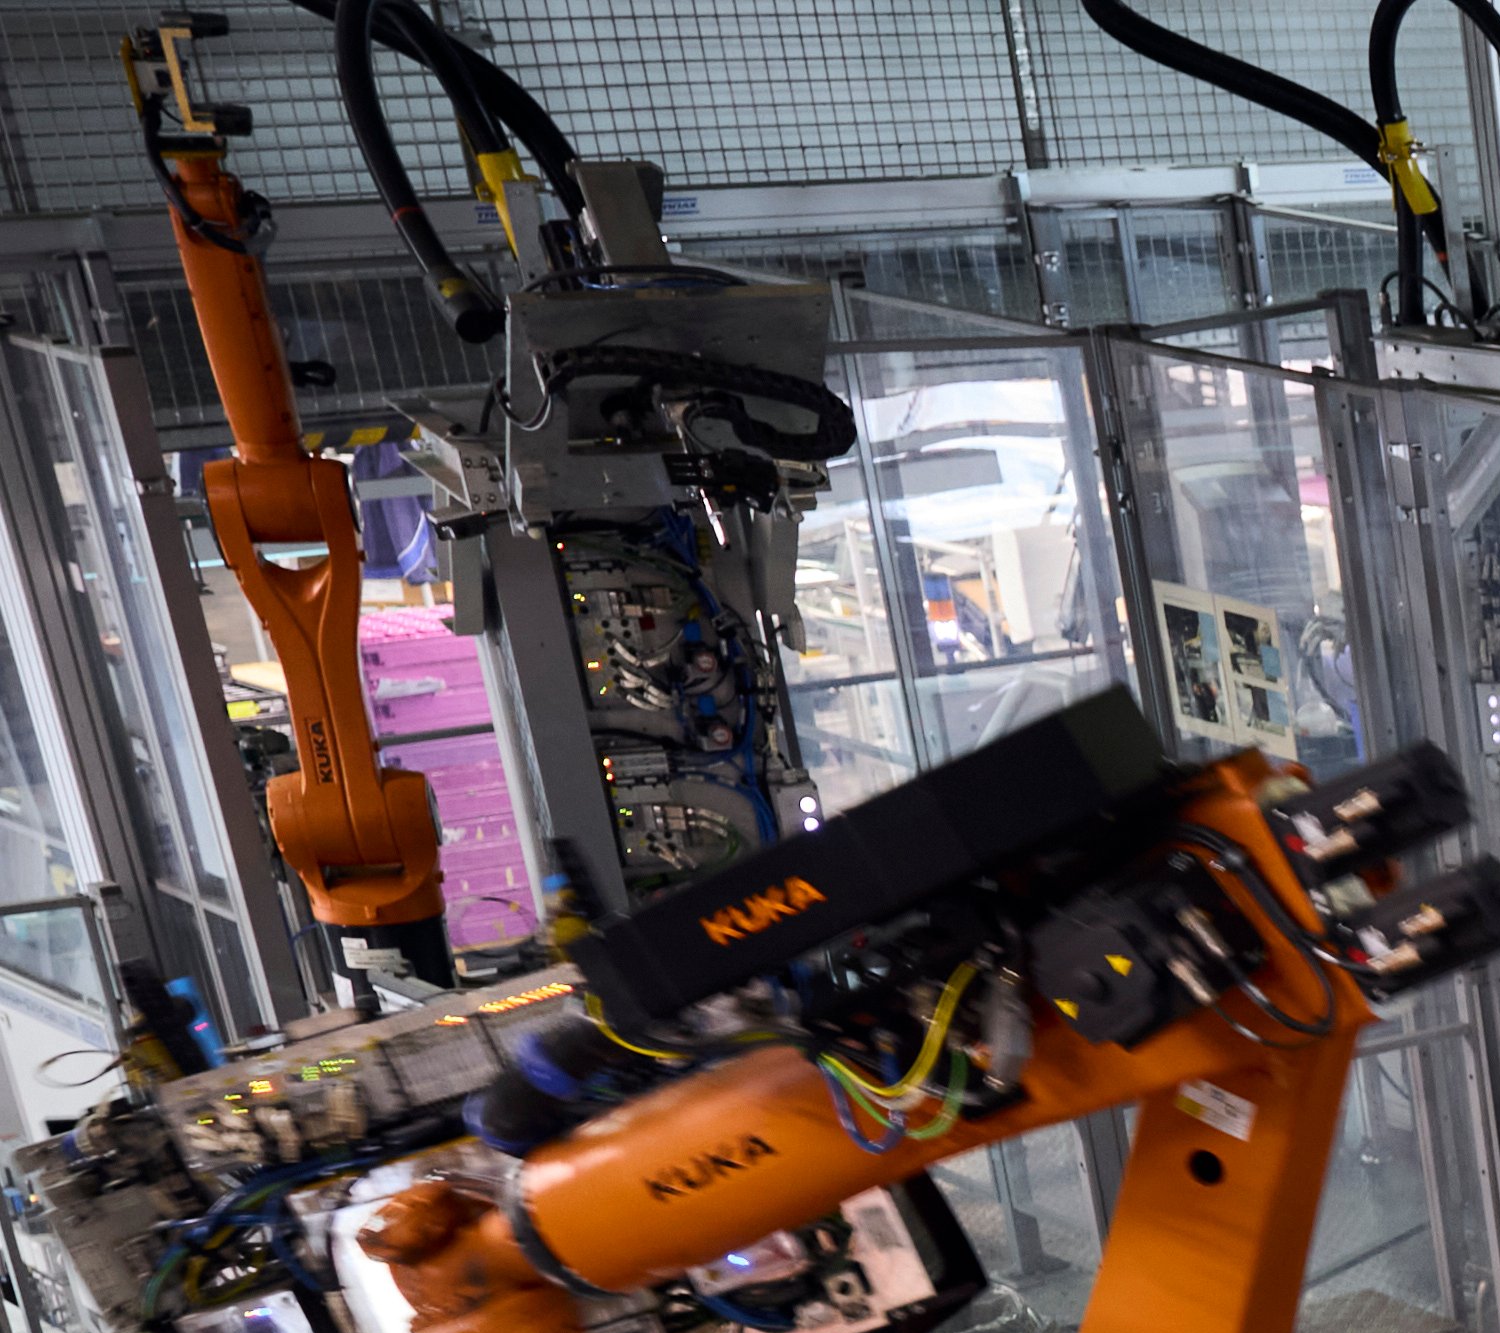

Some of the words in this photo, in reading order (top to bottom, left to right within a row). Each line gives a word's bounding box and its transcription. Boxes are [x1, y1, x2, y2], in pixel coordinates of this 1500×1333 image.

[311, 721, 334, 783] KUKA
[699, 875, 828, 947] KUKA
[643, 1133, 777, 1203] KUKA
